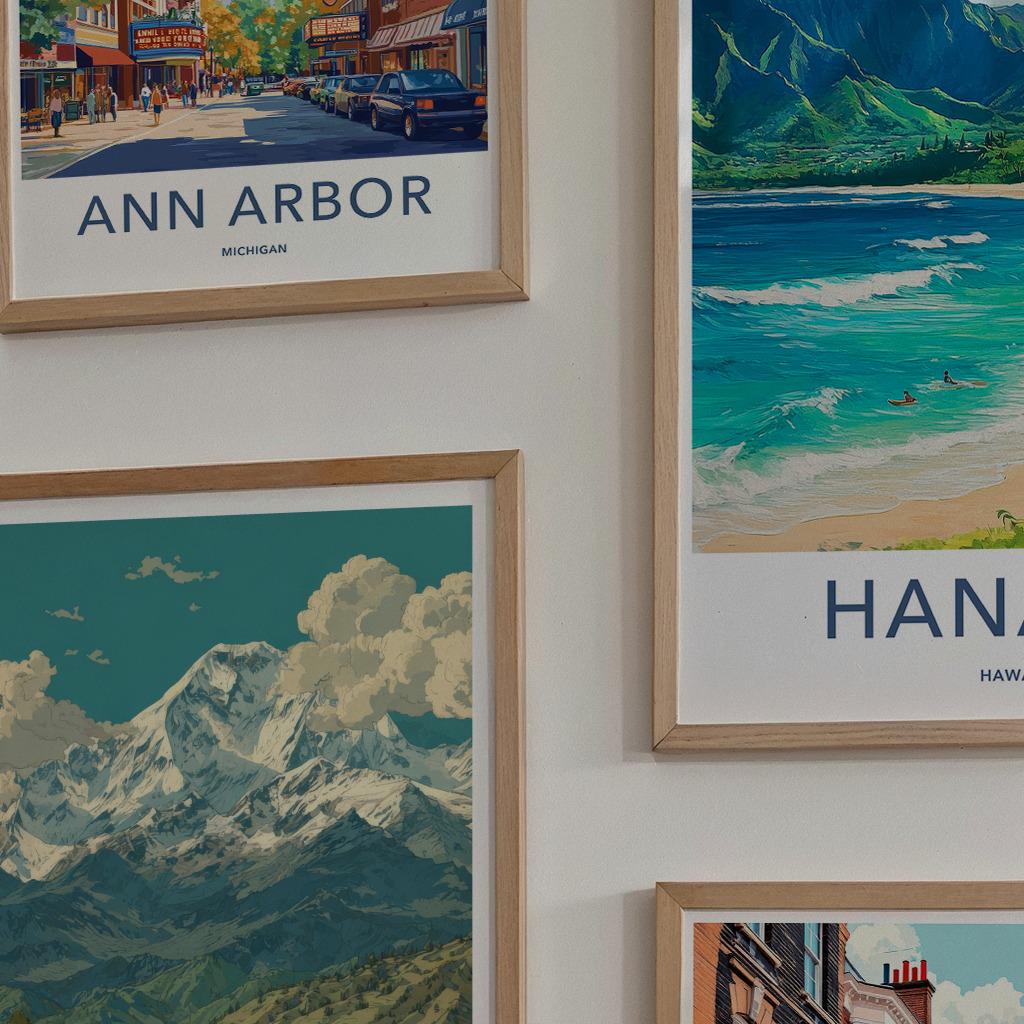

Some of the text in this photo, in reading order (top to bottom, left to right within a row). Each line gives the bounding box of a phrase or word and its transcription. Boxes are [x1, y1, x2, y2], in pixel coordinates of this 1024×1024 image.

[77, 175, 432, 236] ANN ARBOR
[222, 244, 287, 257] MICHIGAN
[826, 576, 1024, 640] HAN
